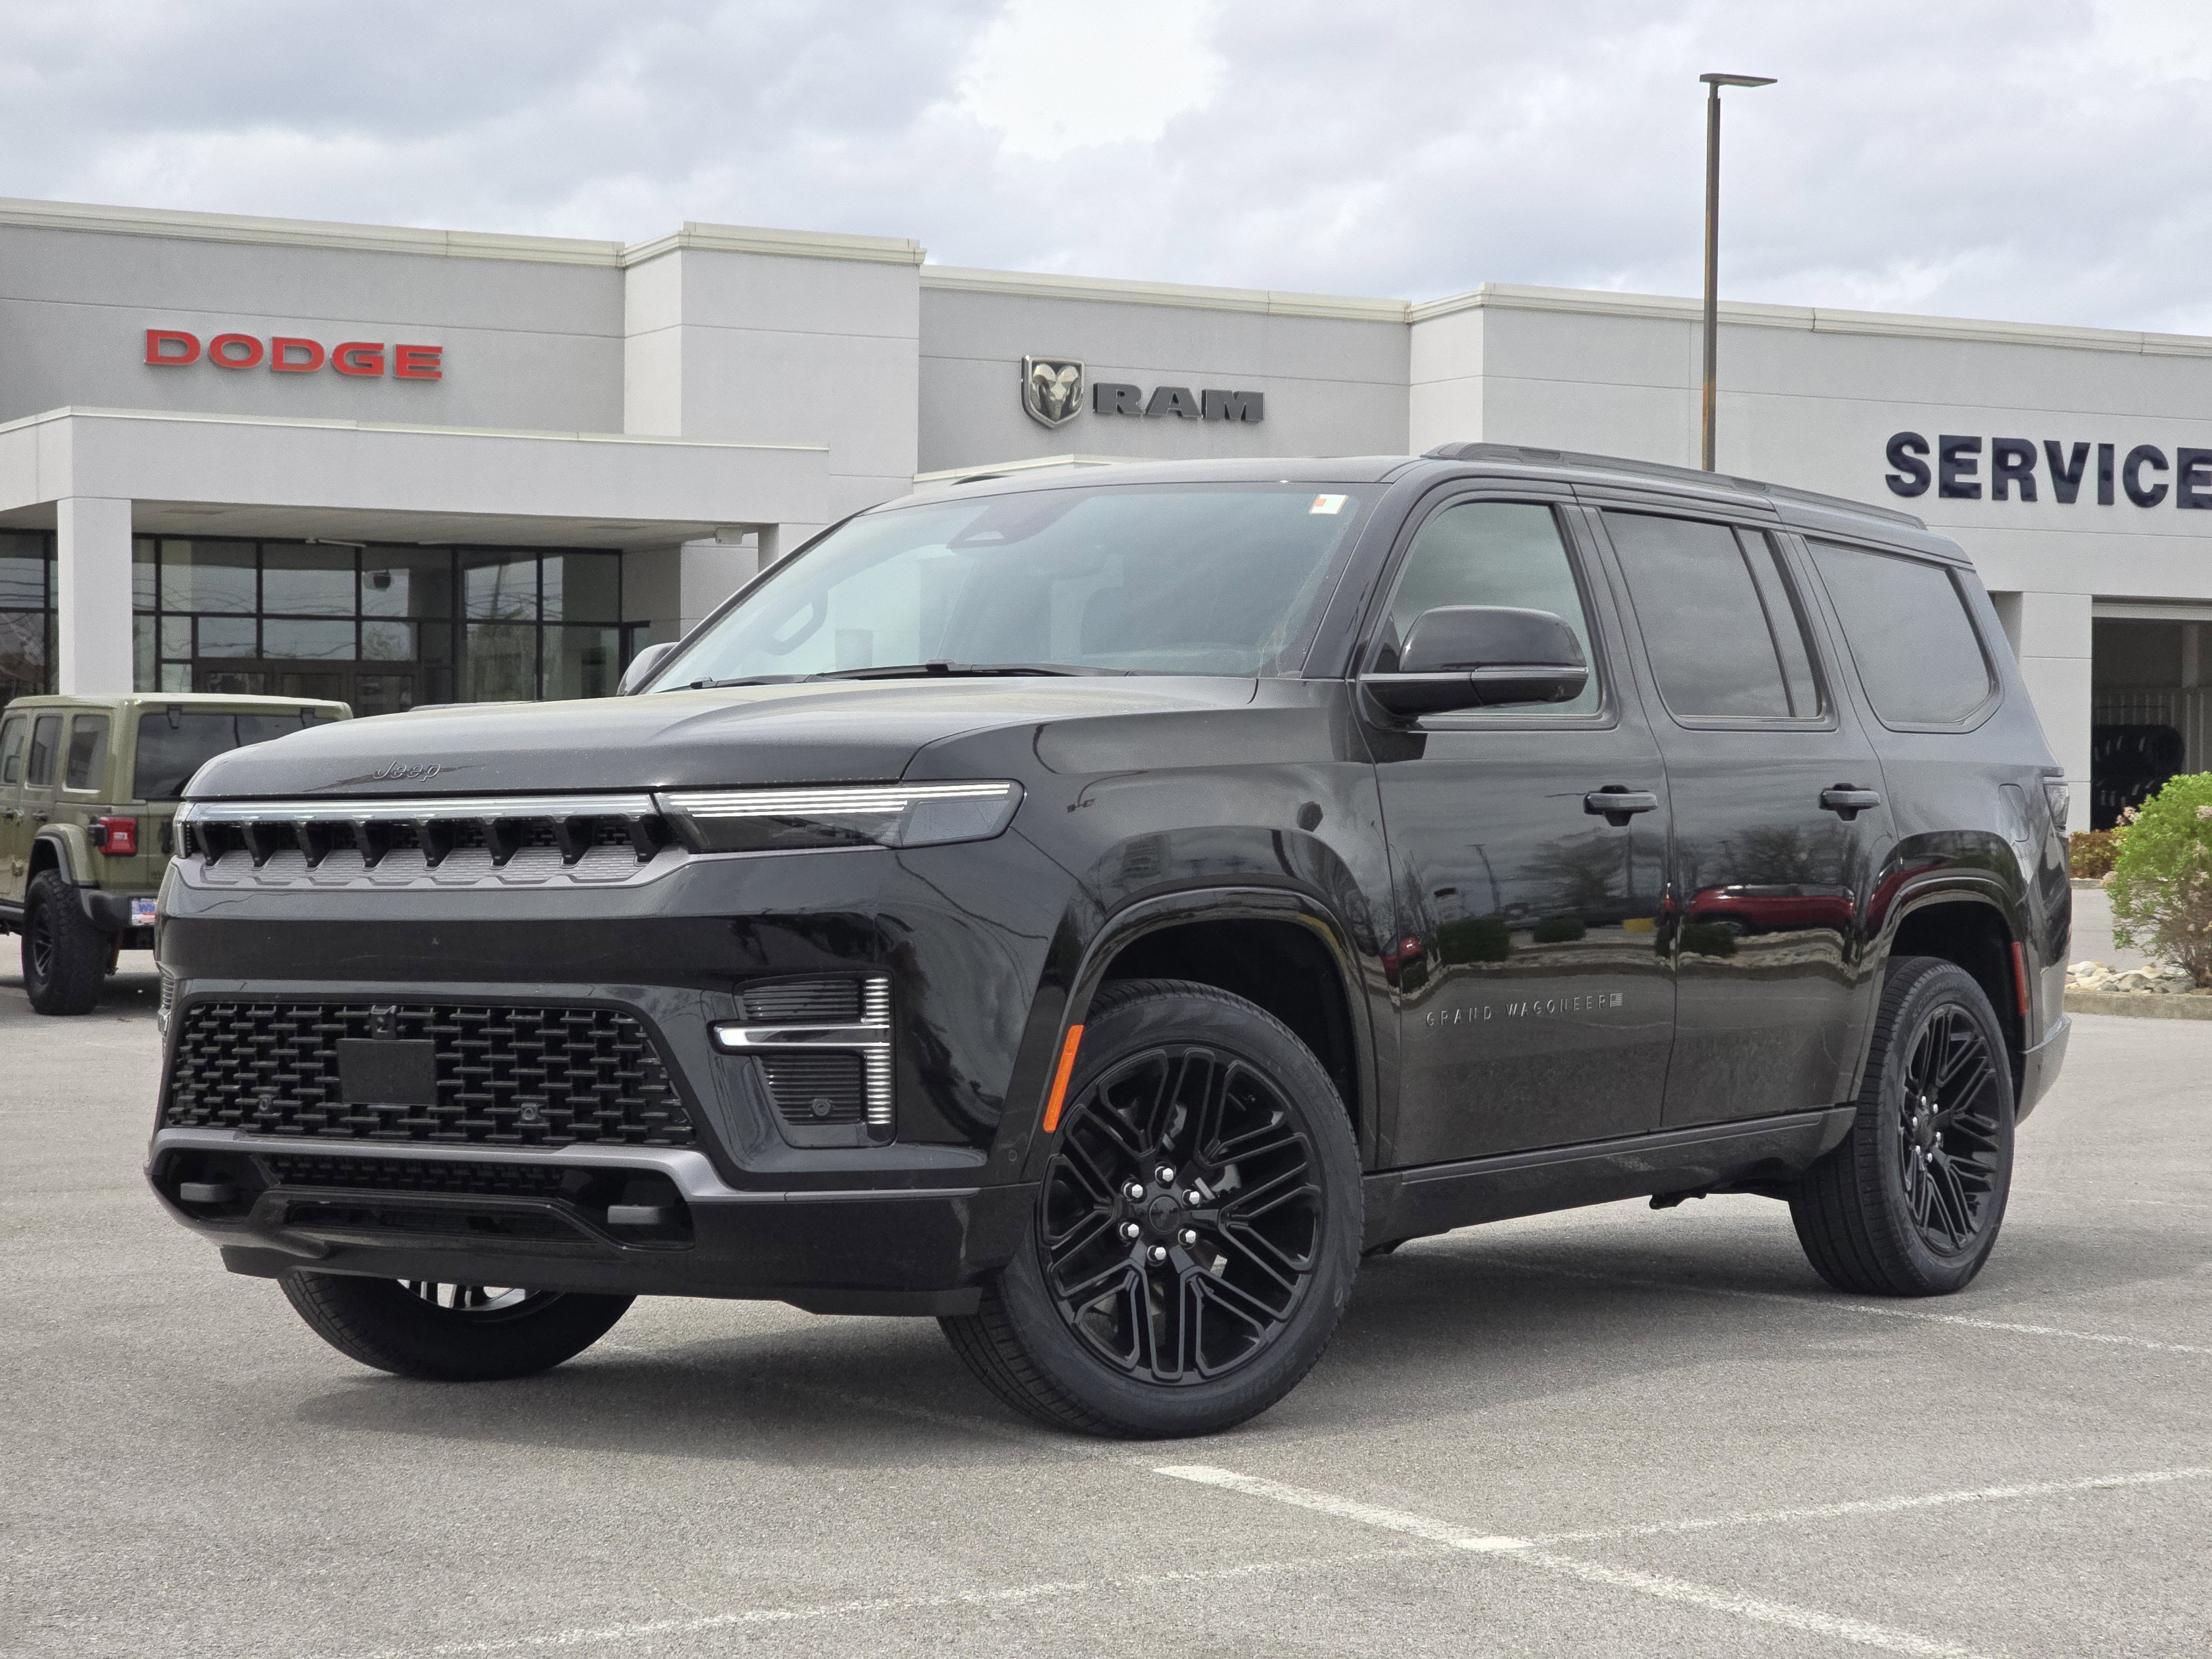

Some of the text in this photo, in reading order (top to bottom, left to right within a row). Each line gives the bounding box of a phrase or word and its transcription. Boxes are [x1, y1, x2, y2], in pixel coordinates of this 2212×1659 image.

[145, 329, 443, 379] DODGE
[1093, 382, 1265, 420] RAM
[1885, 431, 2212, 509] SERVICE
[373, 760, 441, 781] Jeep
[1426, 994, 1606, 1026] GRAND WAGONEER
